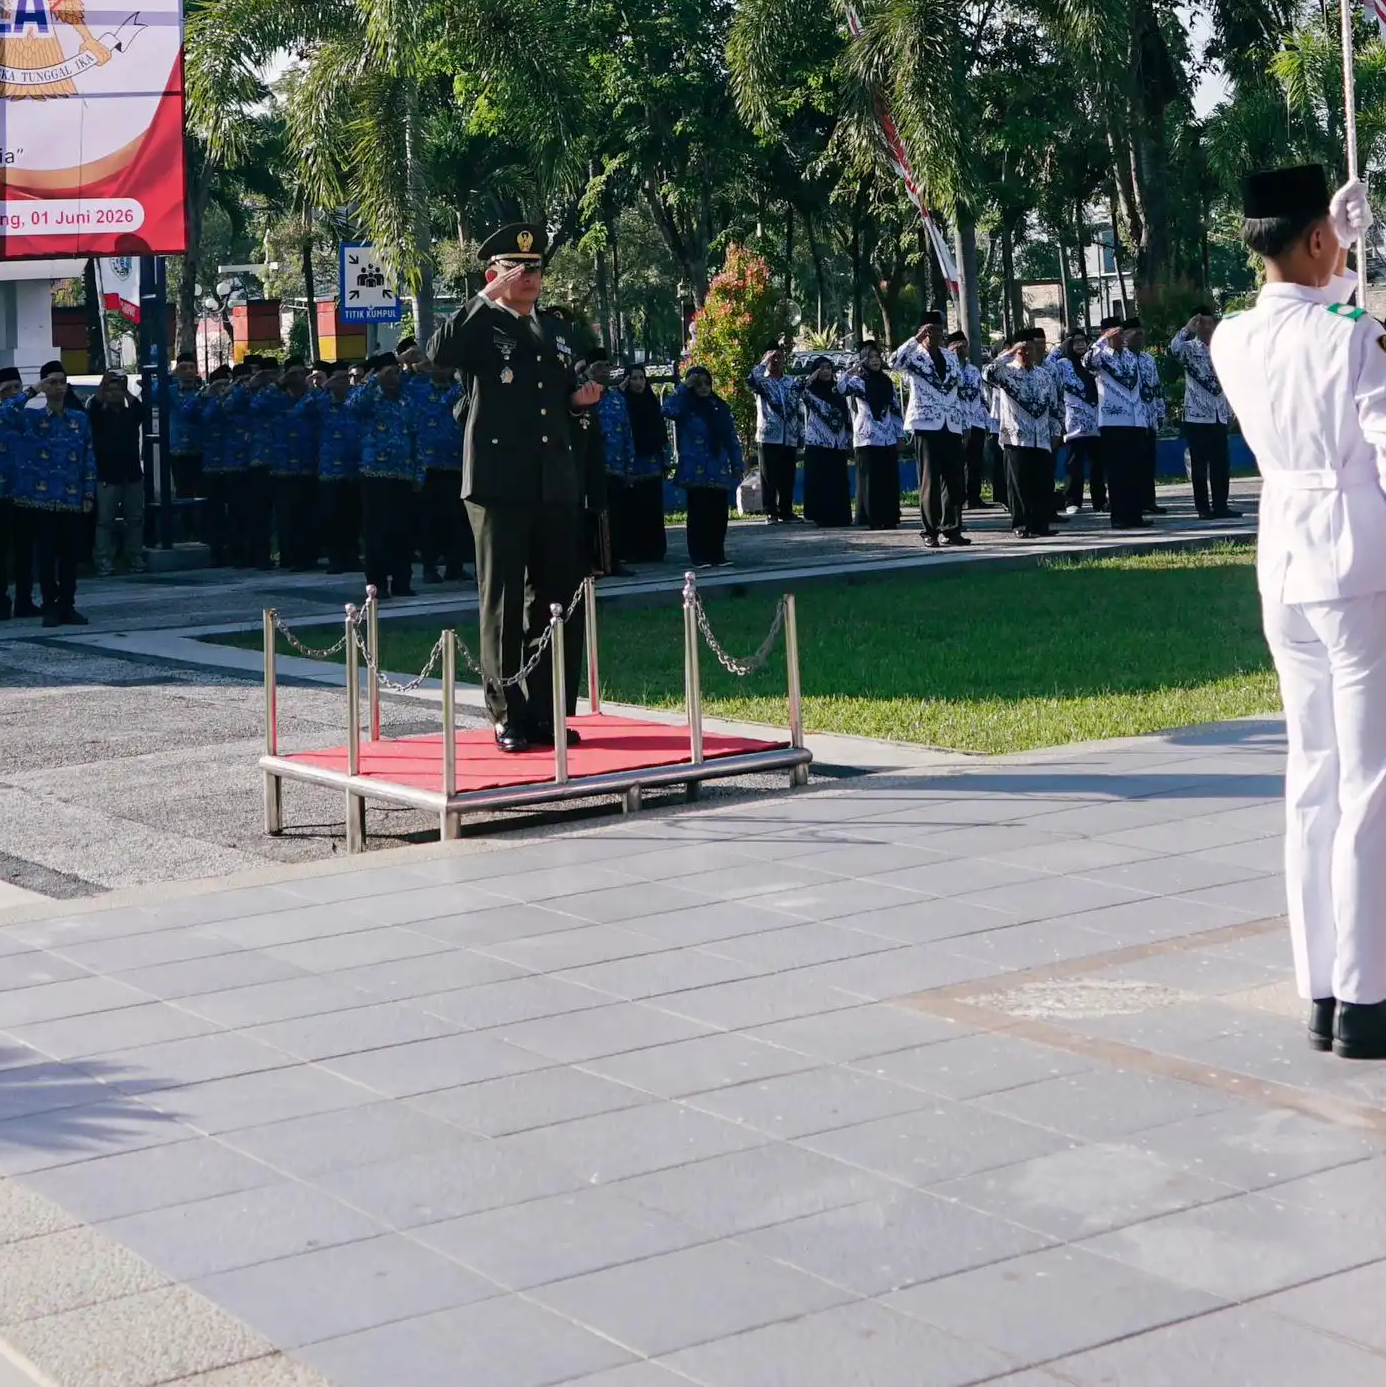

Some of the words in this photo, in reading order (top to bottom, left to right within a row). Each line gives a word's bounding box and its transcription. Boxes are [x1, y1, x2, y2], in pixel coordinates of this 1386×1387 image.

[21, 66, 72, 83] TUNGGAL
[75, 53, 95, 69] IKA
[31, 211, 49, 225] 01
[55, 210, 91, 225] Juni
[96, 209, 134, 224] 2026
[345, 309, 365, 319] TITIK
[366, 309, 397, 319] KUMPUL
